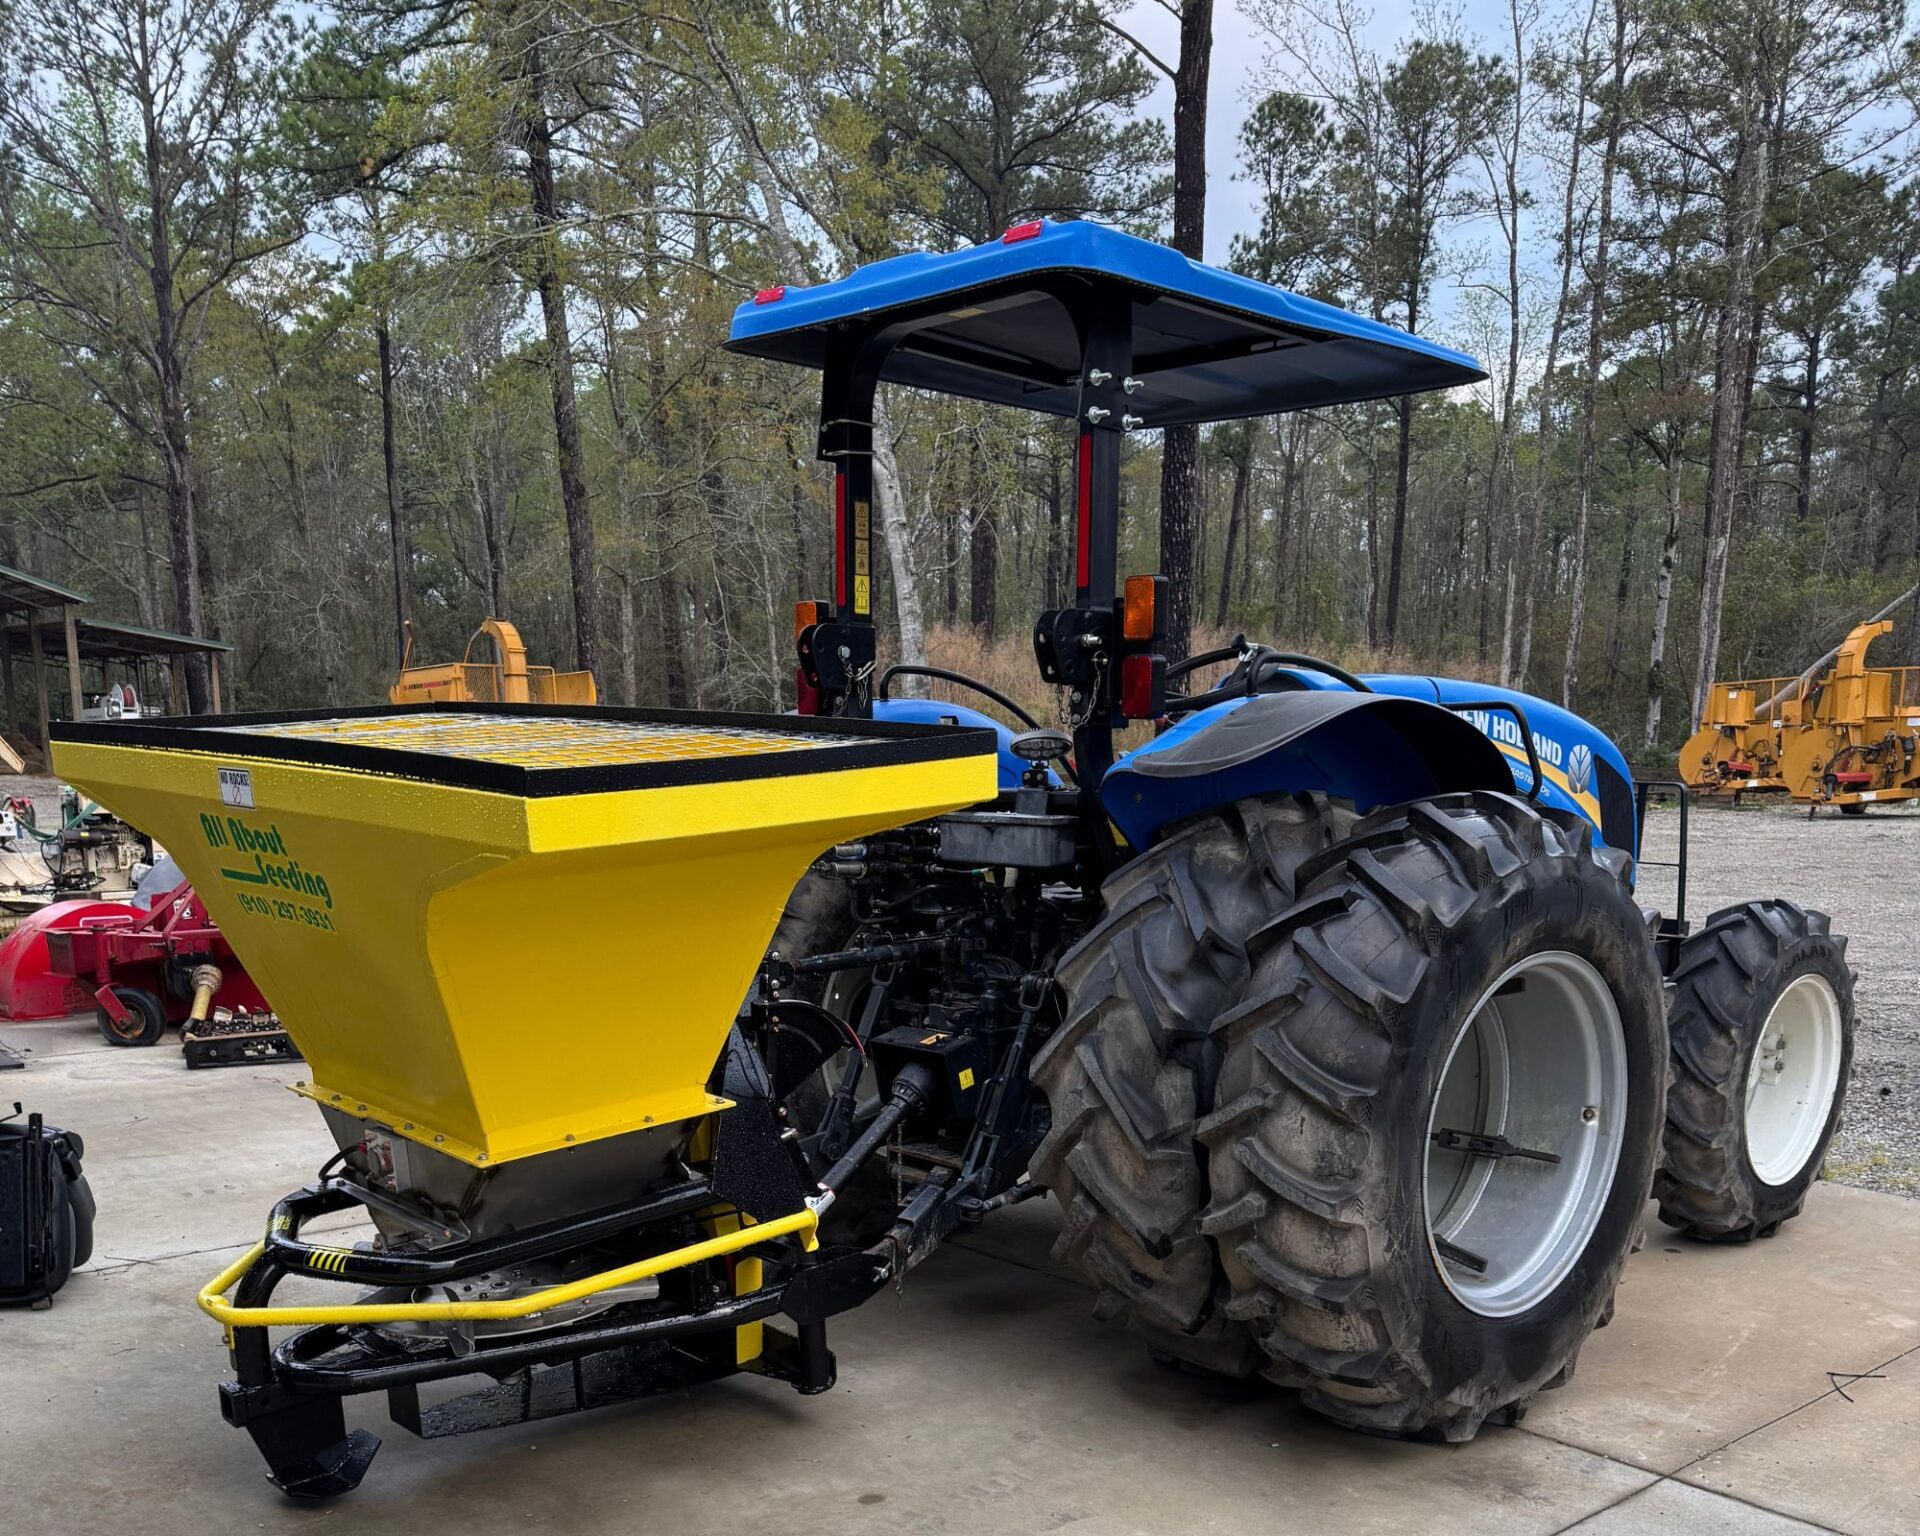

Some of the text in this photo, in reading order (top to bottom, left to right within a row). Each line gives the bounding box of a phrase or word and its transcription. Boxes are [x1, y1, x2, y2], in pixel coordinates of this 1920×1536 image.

[1493, 715, 1562, 766] HOLAND
[200, 813, 288, 857] All About
[221, 854, 332, 909] Seeding
[237, 892, 336, 932] (910) 297-3931
